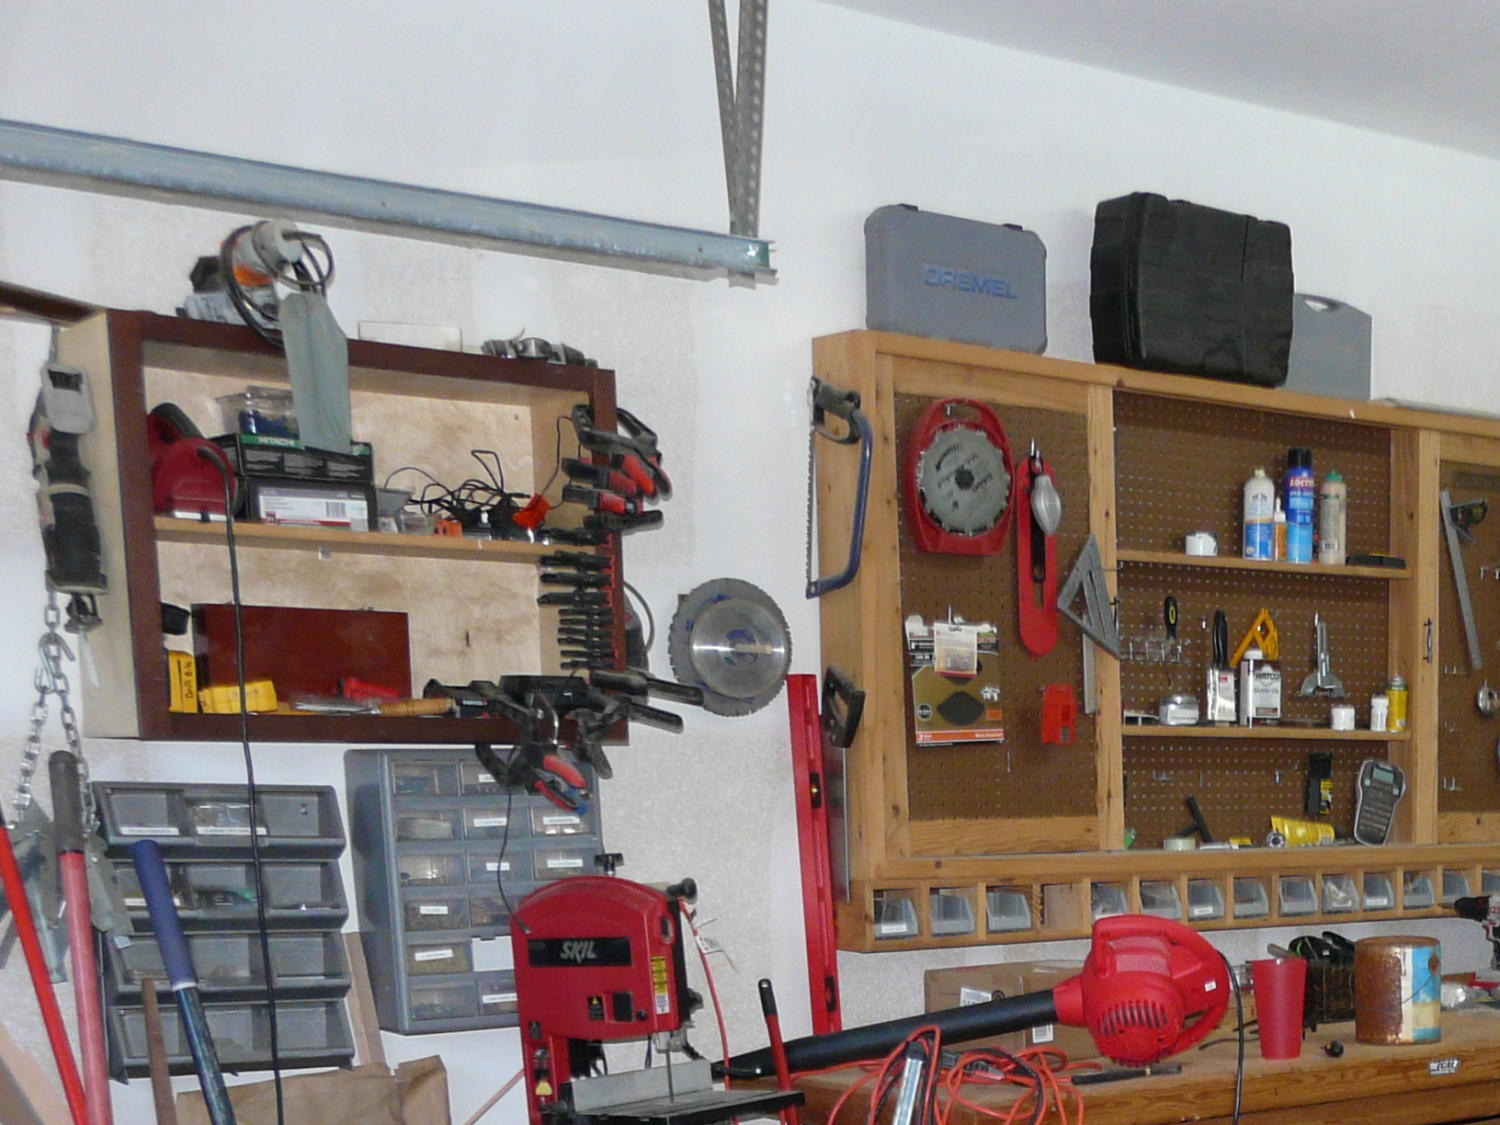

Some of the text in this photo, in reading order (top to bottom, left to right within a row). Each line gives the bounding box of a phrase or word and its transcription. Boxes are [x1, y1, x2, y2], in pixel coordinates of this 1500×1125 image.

[923, 265, 1017, 299] DREMEL
[1289, 478, 1315, 487] LOCTI
[559, 941, 597, 964] SKIL
